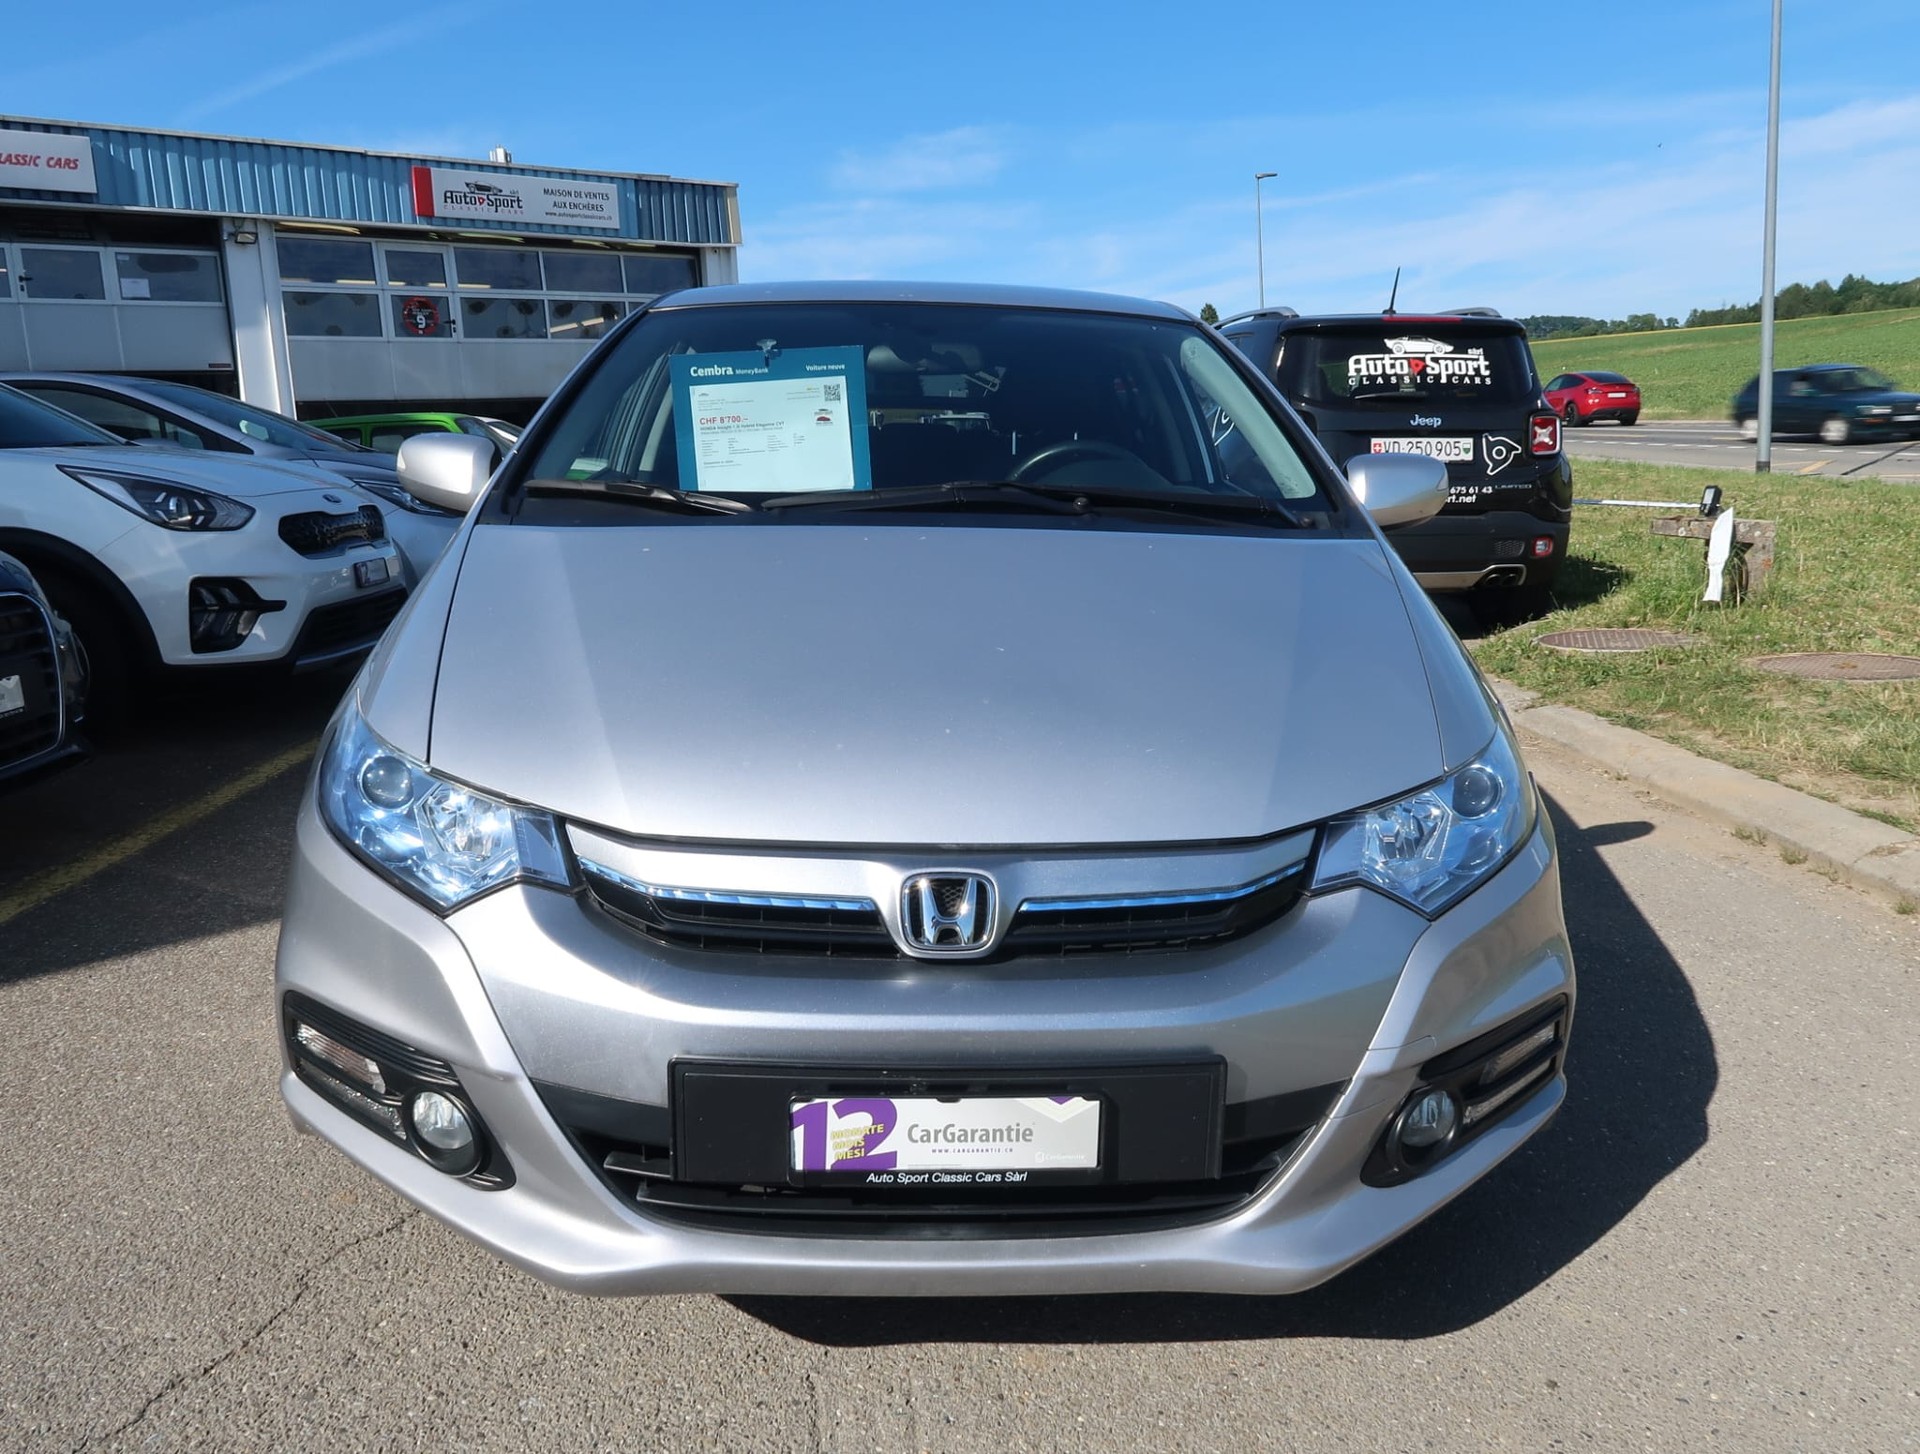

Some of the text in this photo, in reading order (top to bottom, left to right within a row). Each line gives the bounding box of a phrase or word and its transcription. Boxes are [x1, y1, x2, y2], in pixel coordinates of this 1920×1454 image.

[0, 153, 79, 170] LASSIC CARS
[543, 187, 610, 201] MAISON DE VENTES
[443, 190, 523, 213] Auto Sport
[553, 200, 605, 212] AUX ENCHÈRES
[690, 364, 769, 377] Cembra MoneyBank
[827, 363, 845, 371] neuve
[1348, 353, 1490, 384] Auto Sport
[1348, 375, 1492, 386] CLASSIC CARS
[700, 416, 717, 425] CHF
[1410, 413, 1442, 428] Jeep
[1450, 486, 1493, 494] 675 61 43
[1445, 494, 1477, 503] rt.net
[790, 1098, 897, 1171] 12
[907, 1122, 1033, 1145] CarGarantie
[834, 1148, 865, 1160] MESI
[866, 1172, 894, 1183] Auto
[897, 1172, 929, 1186] Sport
[931, 1171, 972, 1183] Classic
[975, 1171, 1002, 1183] Cars
